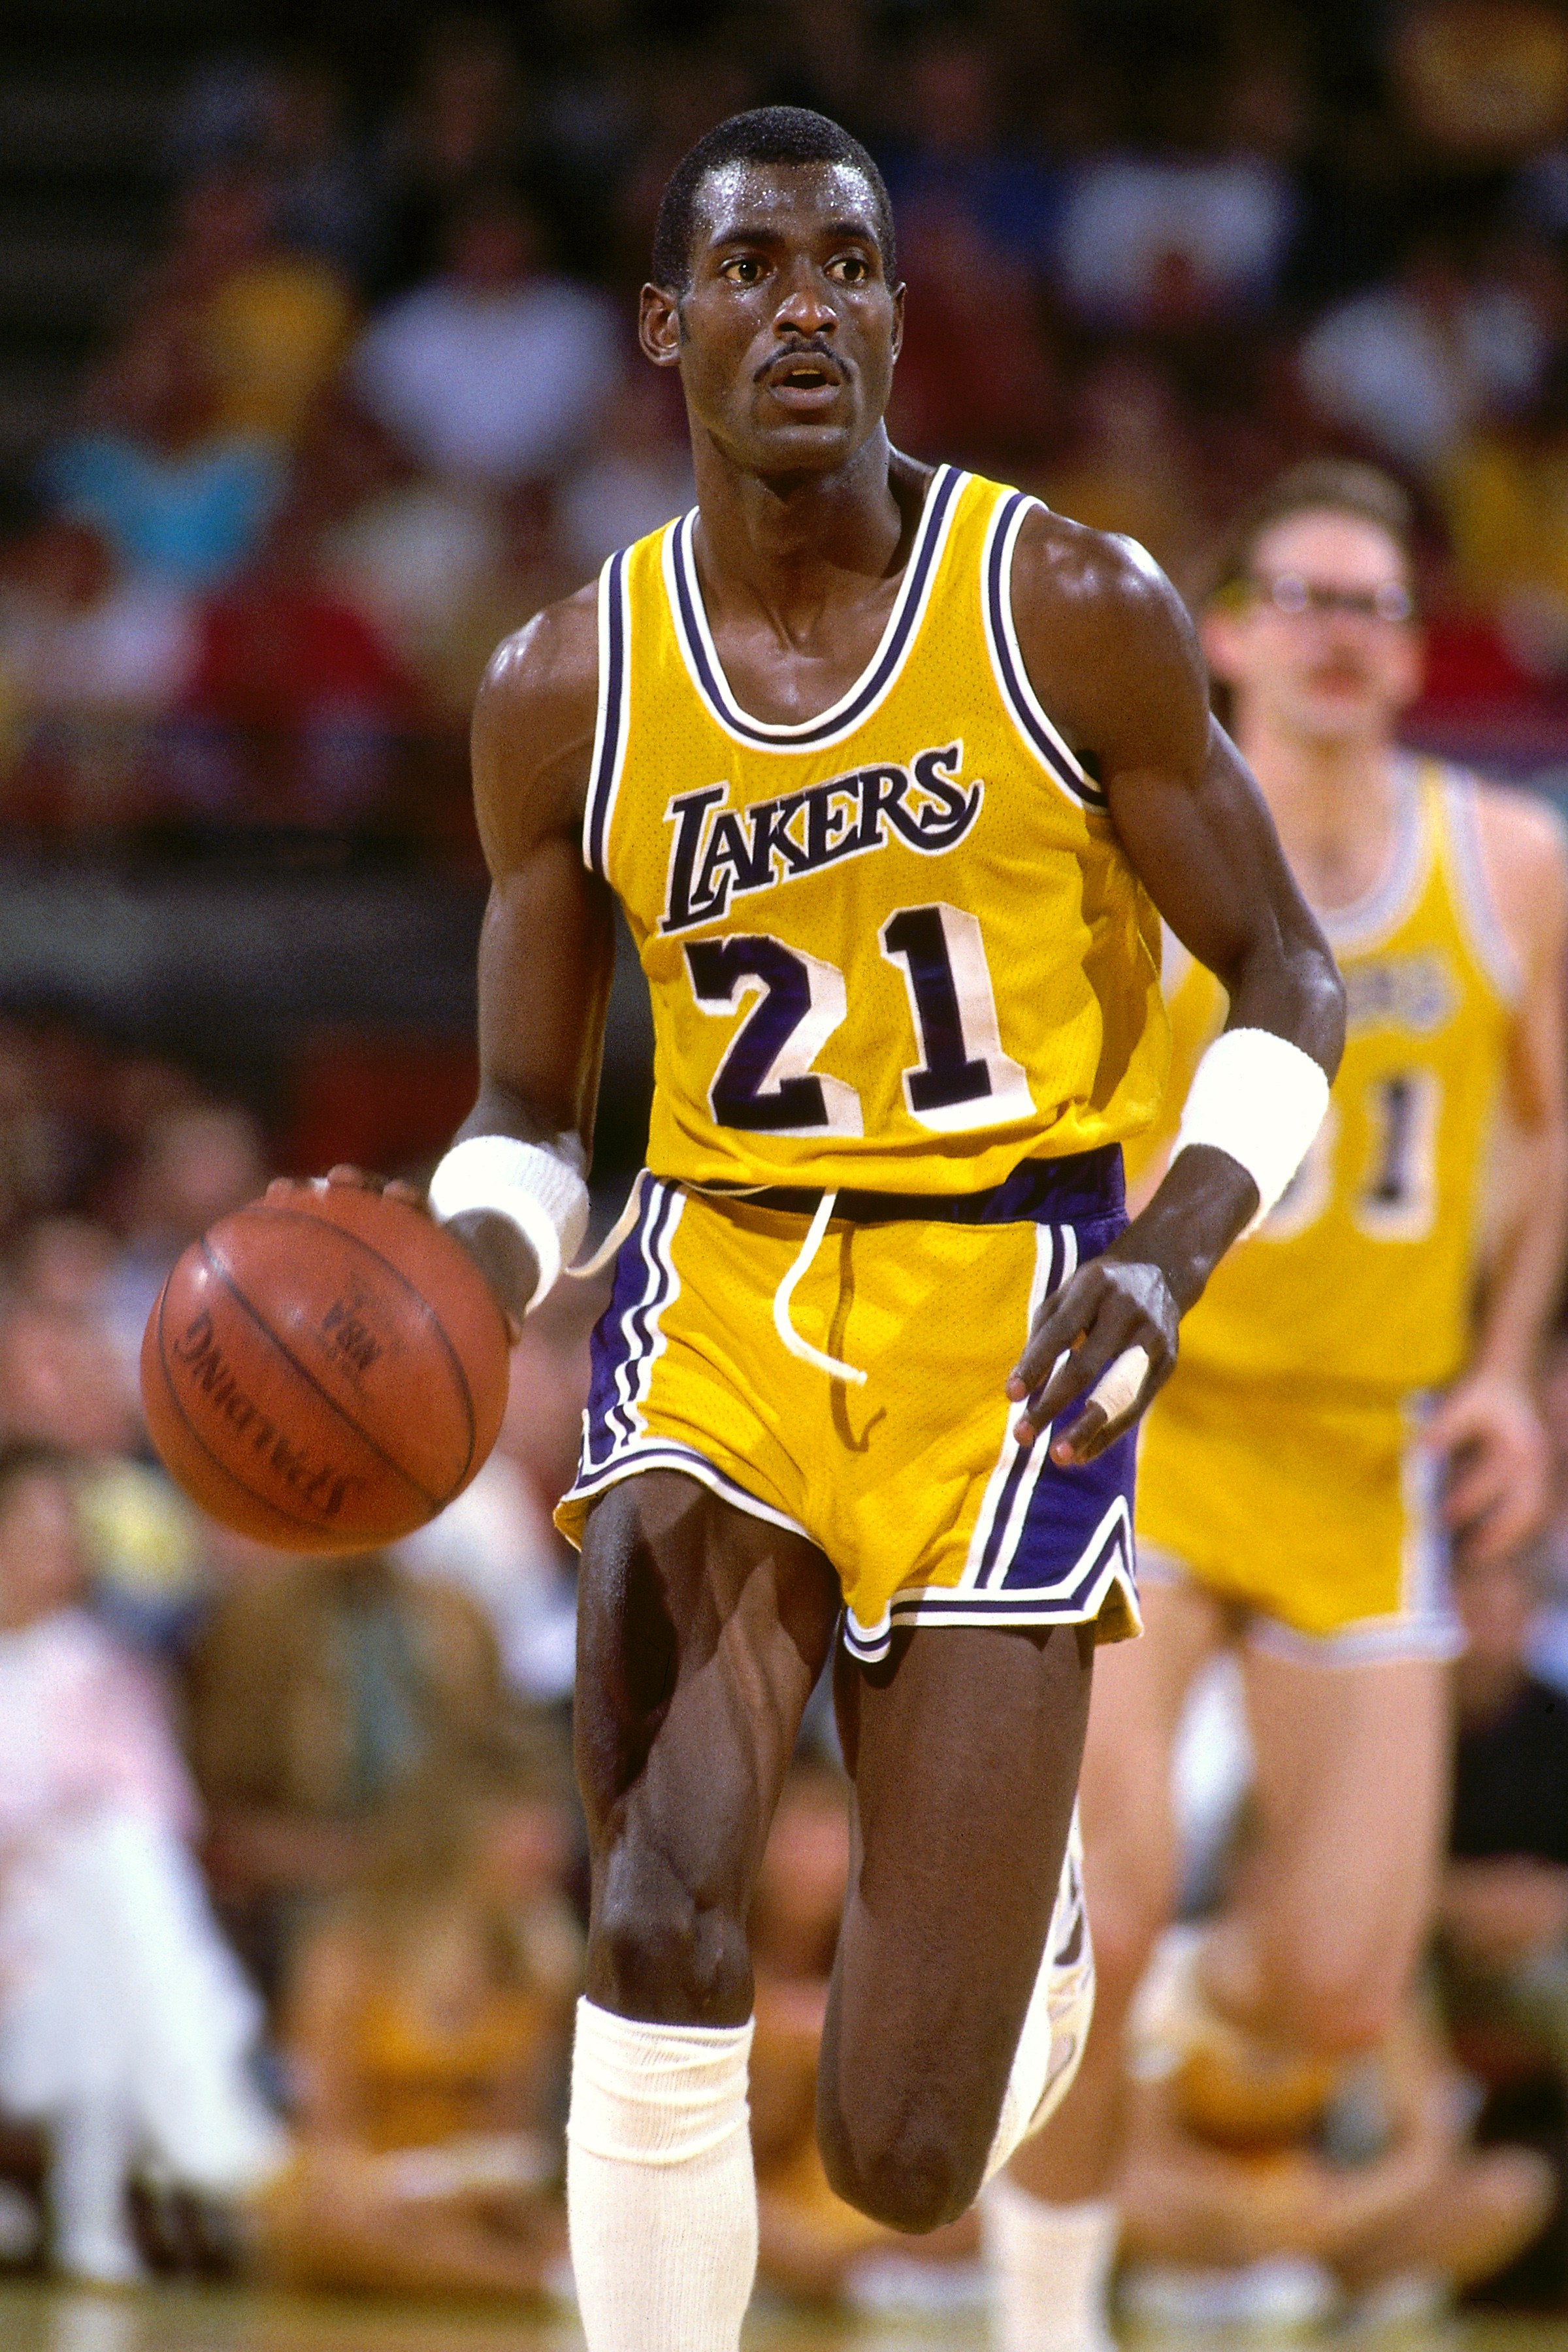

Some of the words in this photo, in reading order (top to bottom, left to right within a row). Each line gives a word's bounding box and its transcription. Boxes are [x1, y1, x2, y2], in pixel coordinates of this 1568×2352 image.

[657, 738, 984, 938] LAKERS
[682, 902, 1037, 1138] 21
[173, 1307, 361, 1517] SPALDING
